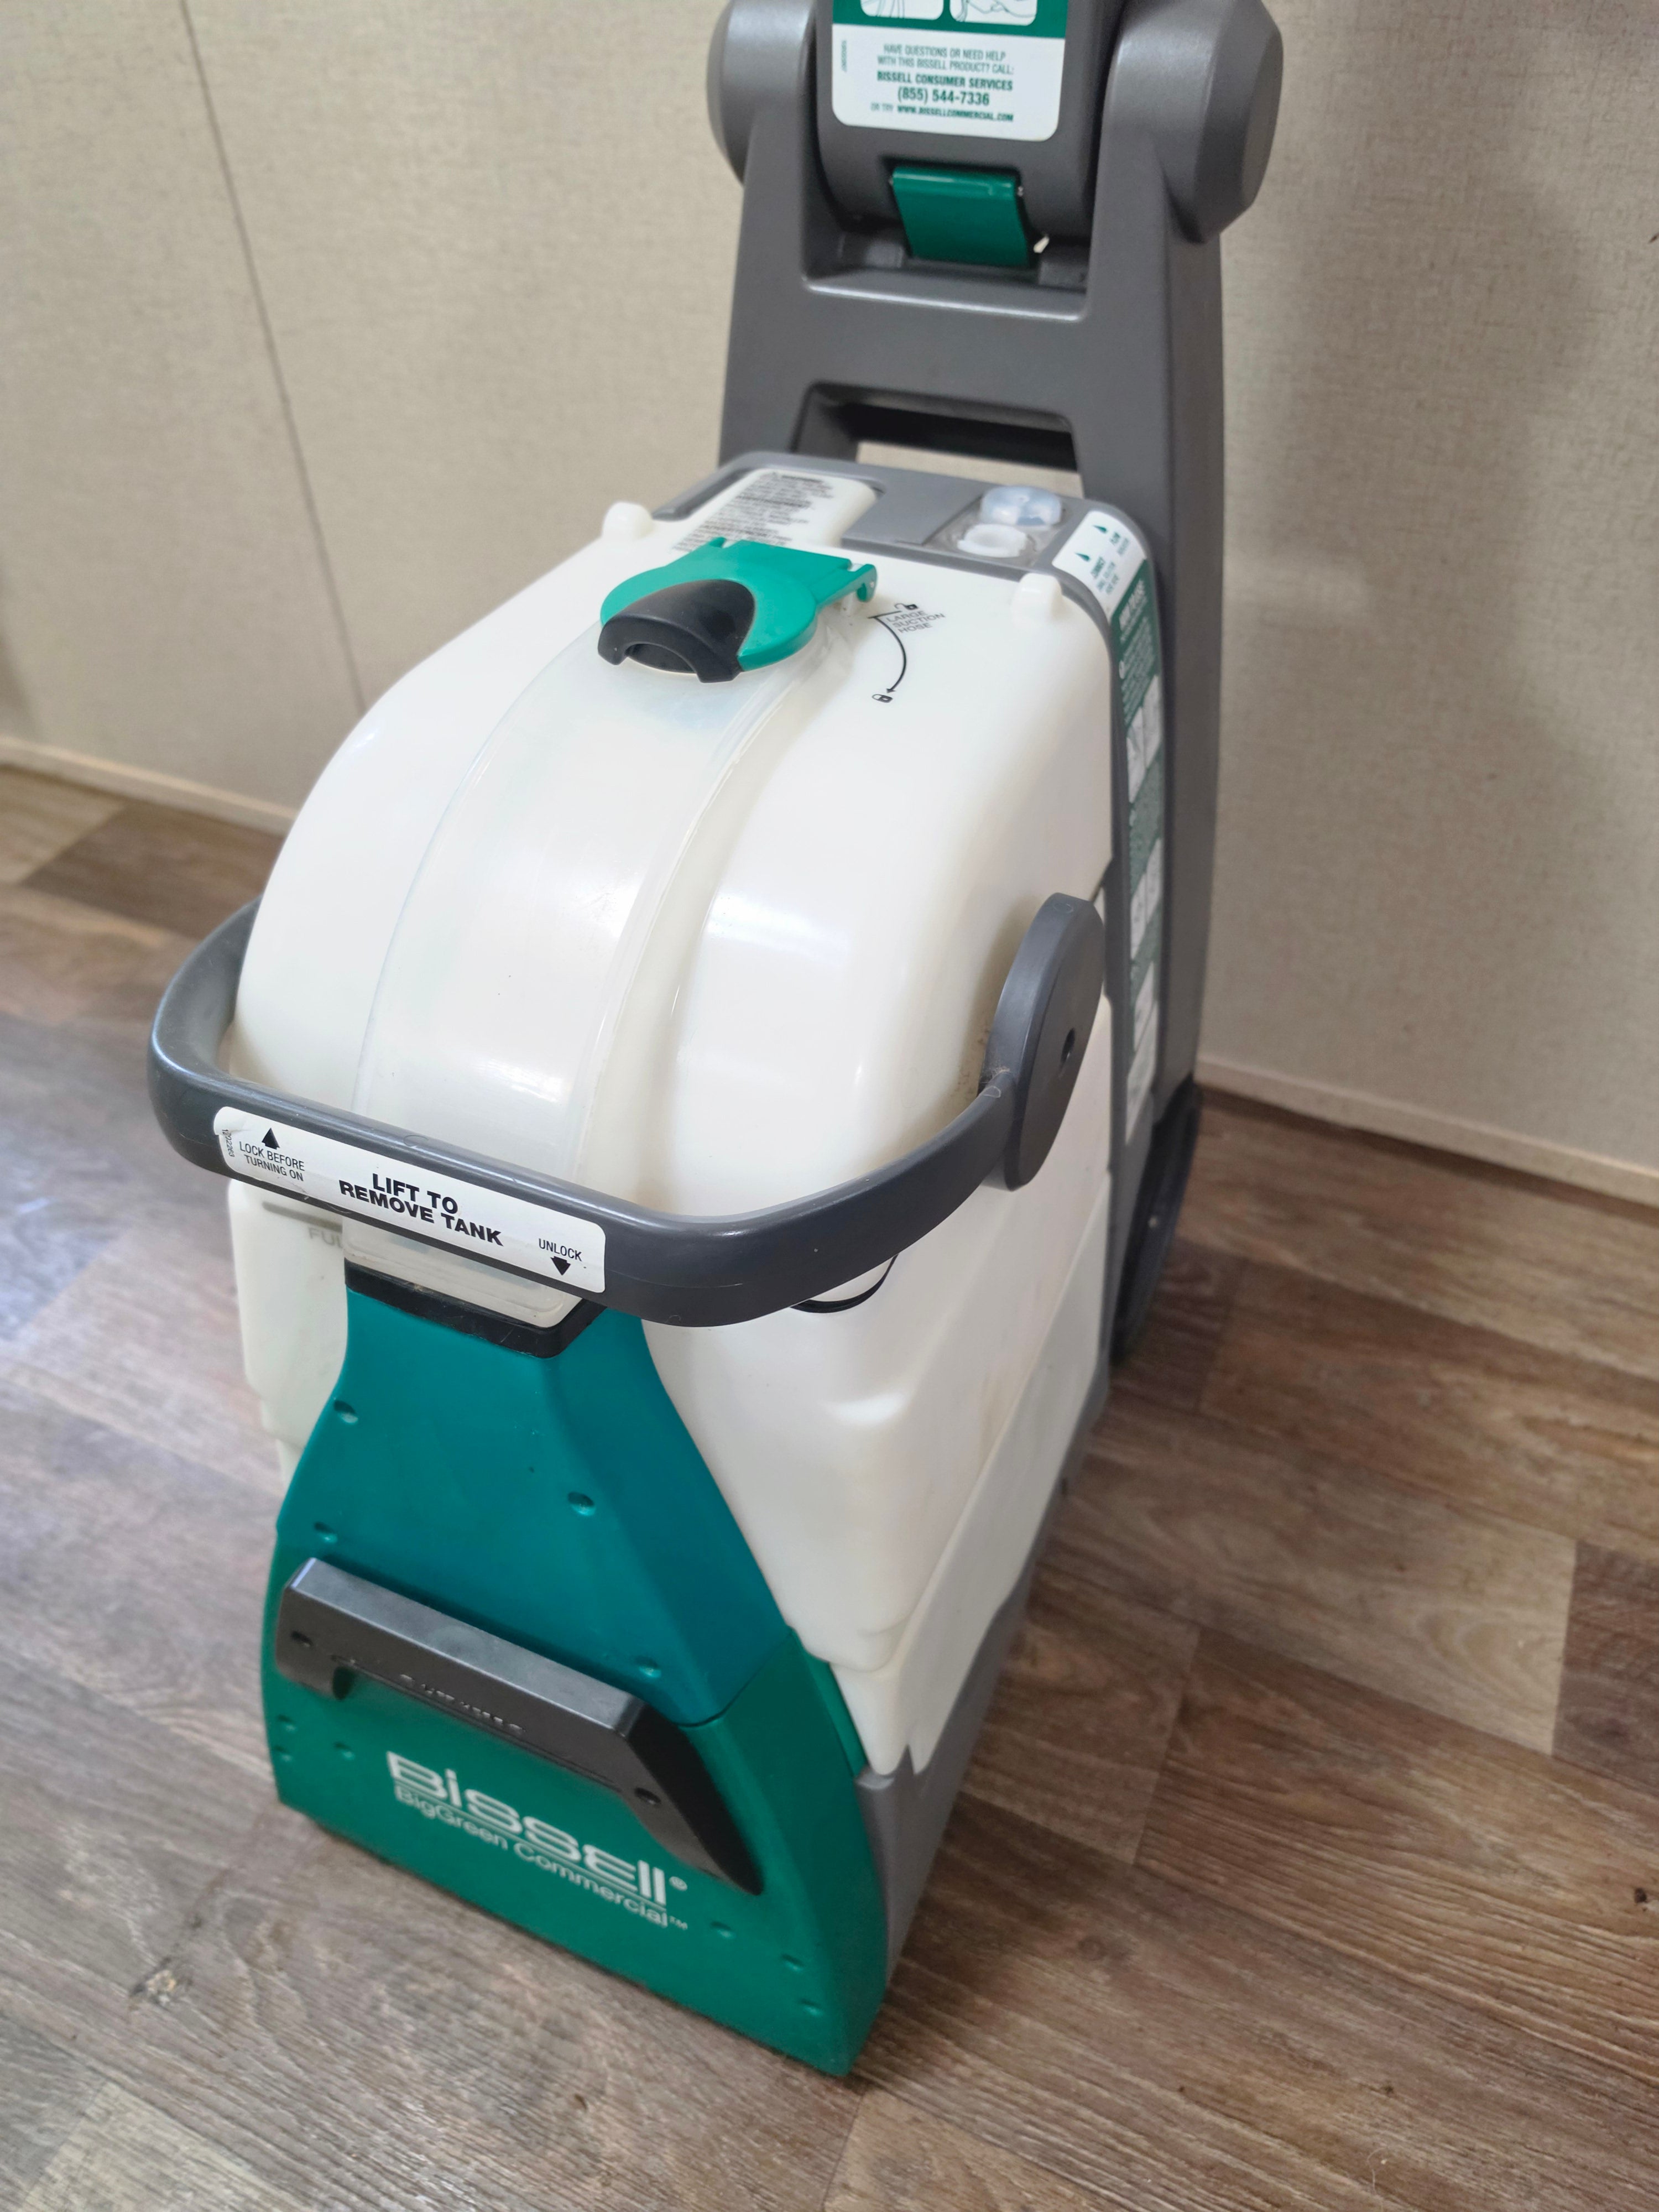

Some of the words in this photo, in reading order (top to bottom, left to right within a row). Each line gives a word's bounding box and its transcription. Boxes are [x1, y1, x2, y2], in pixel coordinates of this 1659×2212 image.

[883, 44, 902, 54] HAVE
[905, 45, 947, 56] QUESTIONS
[950, 48, 961, 58] OR
[963, 49, 983, 60] NEED
[985, 51, 1006, 61] HELP
[878, 56, 896, 65] WITH
[898, 57, 914, 67] THIS
[917, 59, 946, 70] BISSELL
[950, 61, 990, 72] PRODUCT?
[992, 64, 1014, 75] CALL:
[877, 71, 912, 83] BISSELL
[915, 74, 966, 87] CONSUMER
[968, 77, 1013, 91] SERVICES
[898, 86, 928, 105] (855)
[932, 88, 990, 106] 544-7336
[897, 105, 1014, 121] WWW.BISSELLCOMMERCIAL.COM
[886, 611, 927, 622] LARGE
[892, 613, 946, 628] SUCTION
[898, 623, 933, 633] HOSE
[239, 1141, 265, 1159] LOCK
[267, 1150, 305, 1171] BEFORE
[244, 1154, 287, 1176] TURNING
[289, 1170, 304, 1181] ON
[372, 1173, 419, 1202] LIFT
[427, 1191, 458, 1214] TO
[339, 1180, 435, 1223] REMOVE
[441, 1213, 504, 1246] TANK
[539, 1238, 582, 1261] UNLOCK
[394, 1785, 508, 1850] BigGreen
